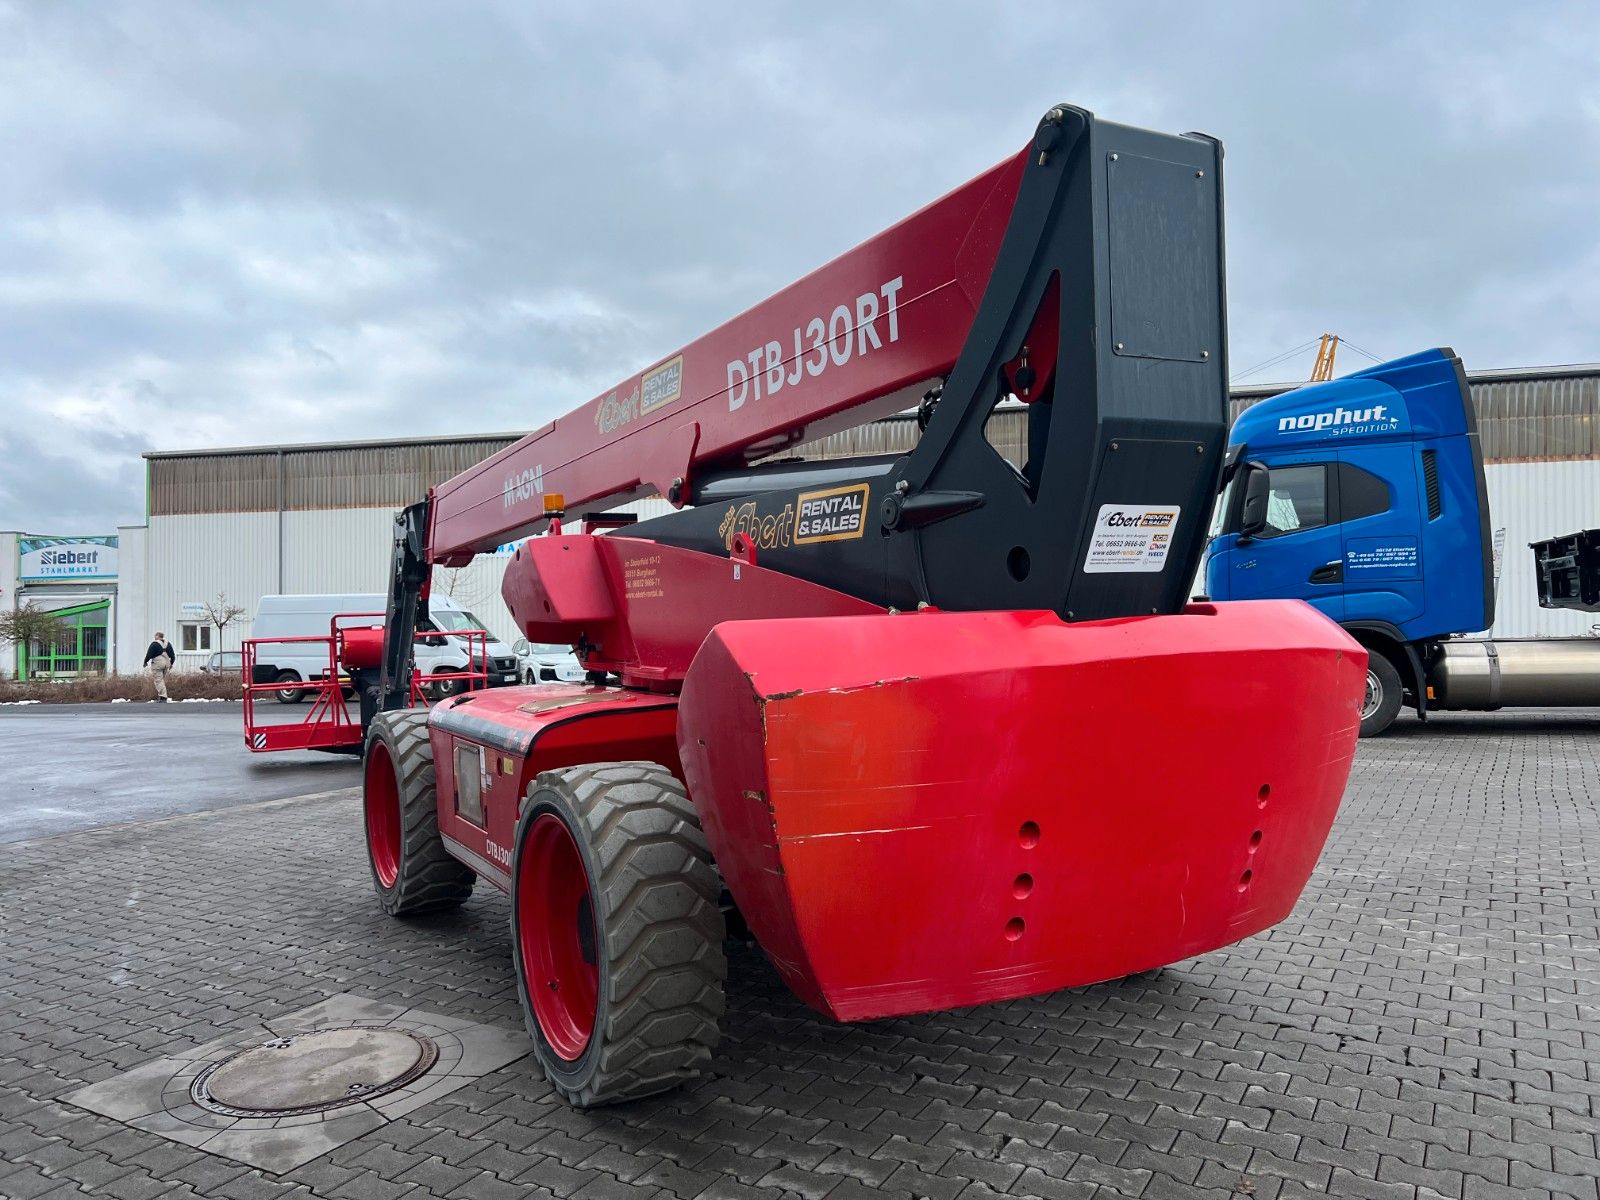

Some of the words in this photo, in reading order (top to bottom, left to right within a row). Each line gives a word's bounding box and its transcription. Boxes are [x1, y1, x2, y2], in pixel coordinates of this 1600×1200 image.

[726, 276, 903, 412] DTBJ30RT
[643, 365, 679, 391] RENTAL
[650, 380, 679, 404] SALES
[1278, 405, 1388, 431] nophut
[1331, 423, 1398, 436] SPEDITION
[504, 464, 544, 508] MAGNI
[801, 494, 862, 518] RENTAL
[799, 521, 810, 536] &
[811, 513, 860, 534] SALES
[1108, 512, 1142, 527] Ebert
[486, 839, 513, 867] DTBJ30
